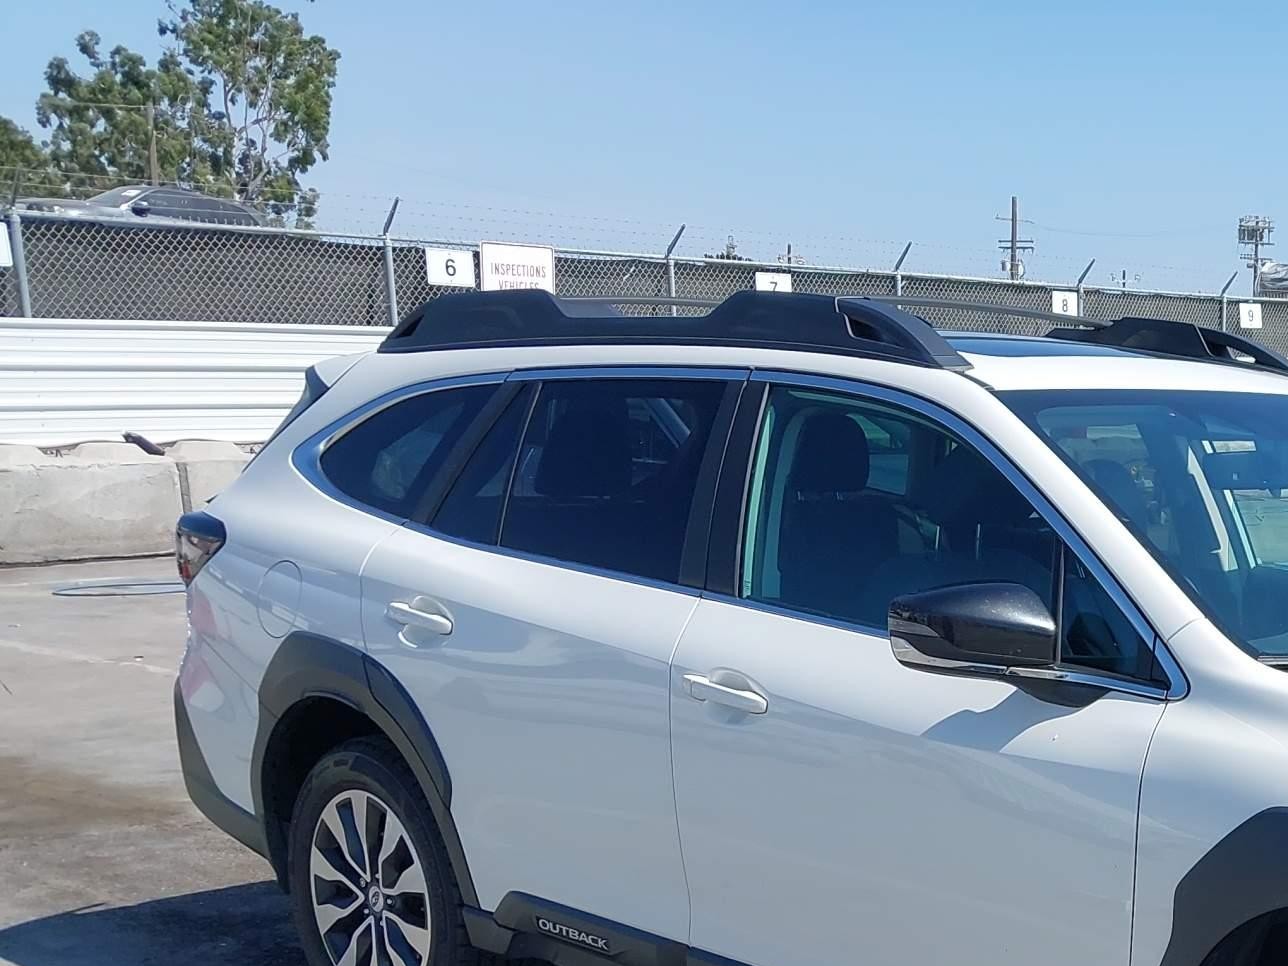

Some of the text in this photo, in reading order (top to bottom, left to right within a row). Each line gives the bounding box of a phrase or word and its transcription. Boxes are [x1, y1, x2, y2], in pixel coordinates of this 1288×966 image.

[445, 259, 456, 276] 6
[490, 262, 547, 279] INSPECTIONS
[768, 281, 777, 291] 7
[1062, 298, 1068, 312] 8
[1247, 310, 1253, 321] 9
[538, 918, 609, 951] OUTBACK
